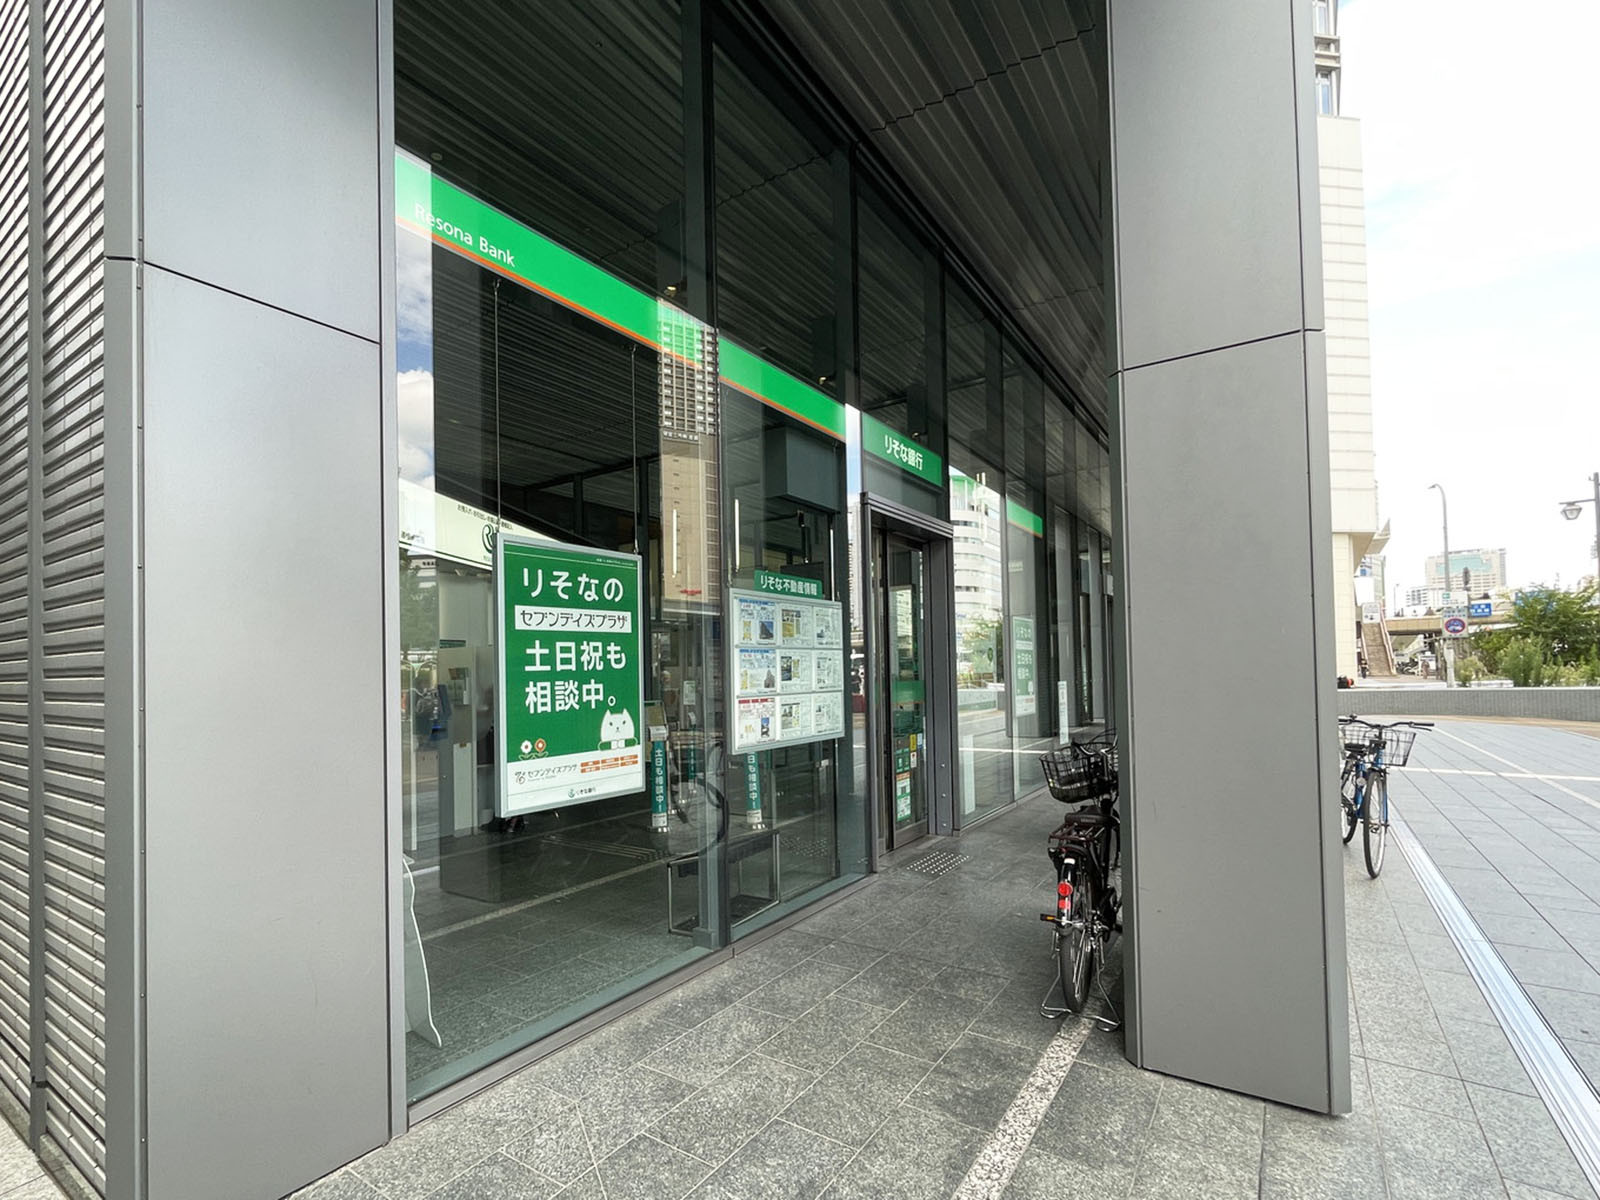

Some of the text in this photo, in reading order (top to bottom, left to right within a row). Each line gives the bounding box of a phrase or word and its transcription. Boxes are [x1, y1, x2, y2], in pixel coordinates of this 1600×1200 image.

[415, 203, 515, 267] Resona Bank
[884, 434, 923, 471] りそな銀行
[522, 567, 624, 602] りそなの
[524, 640, 626, 672] 土日祝も
[525, 679, 617, 714] 相談中。
